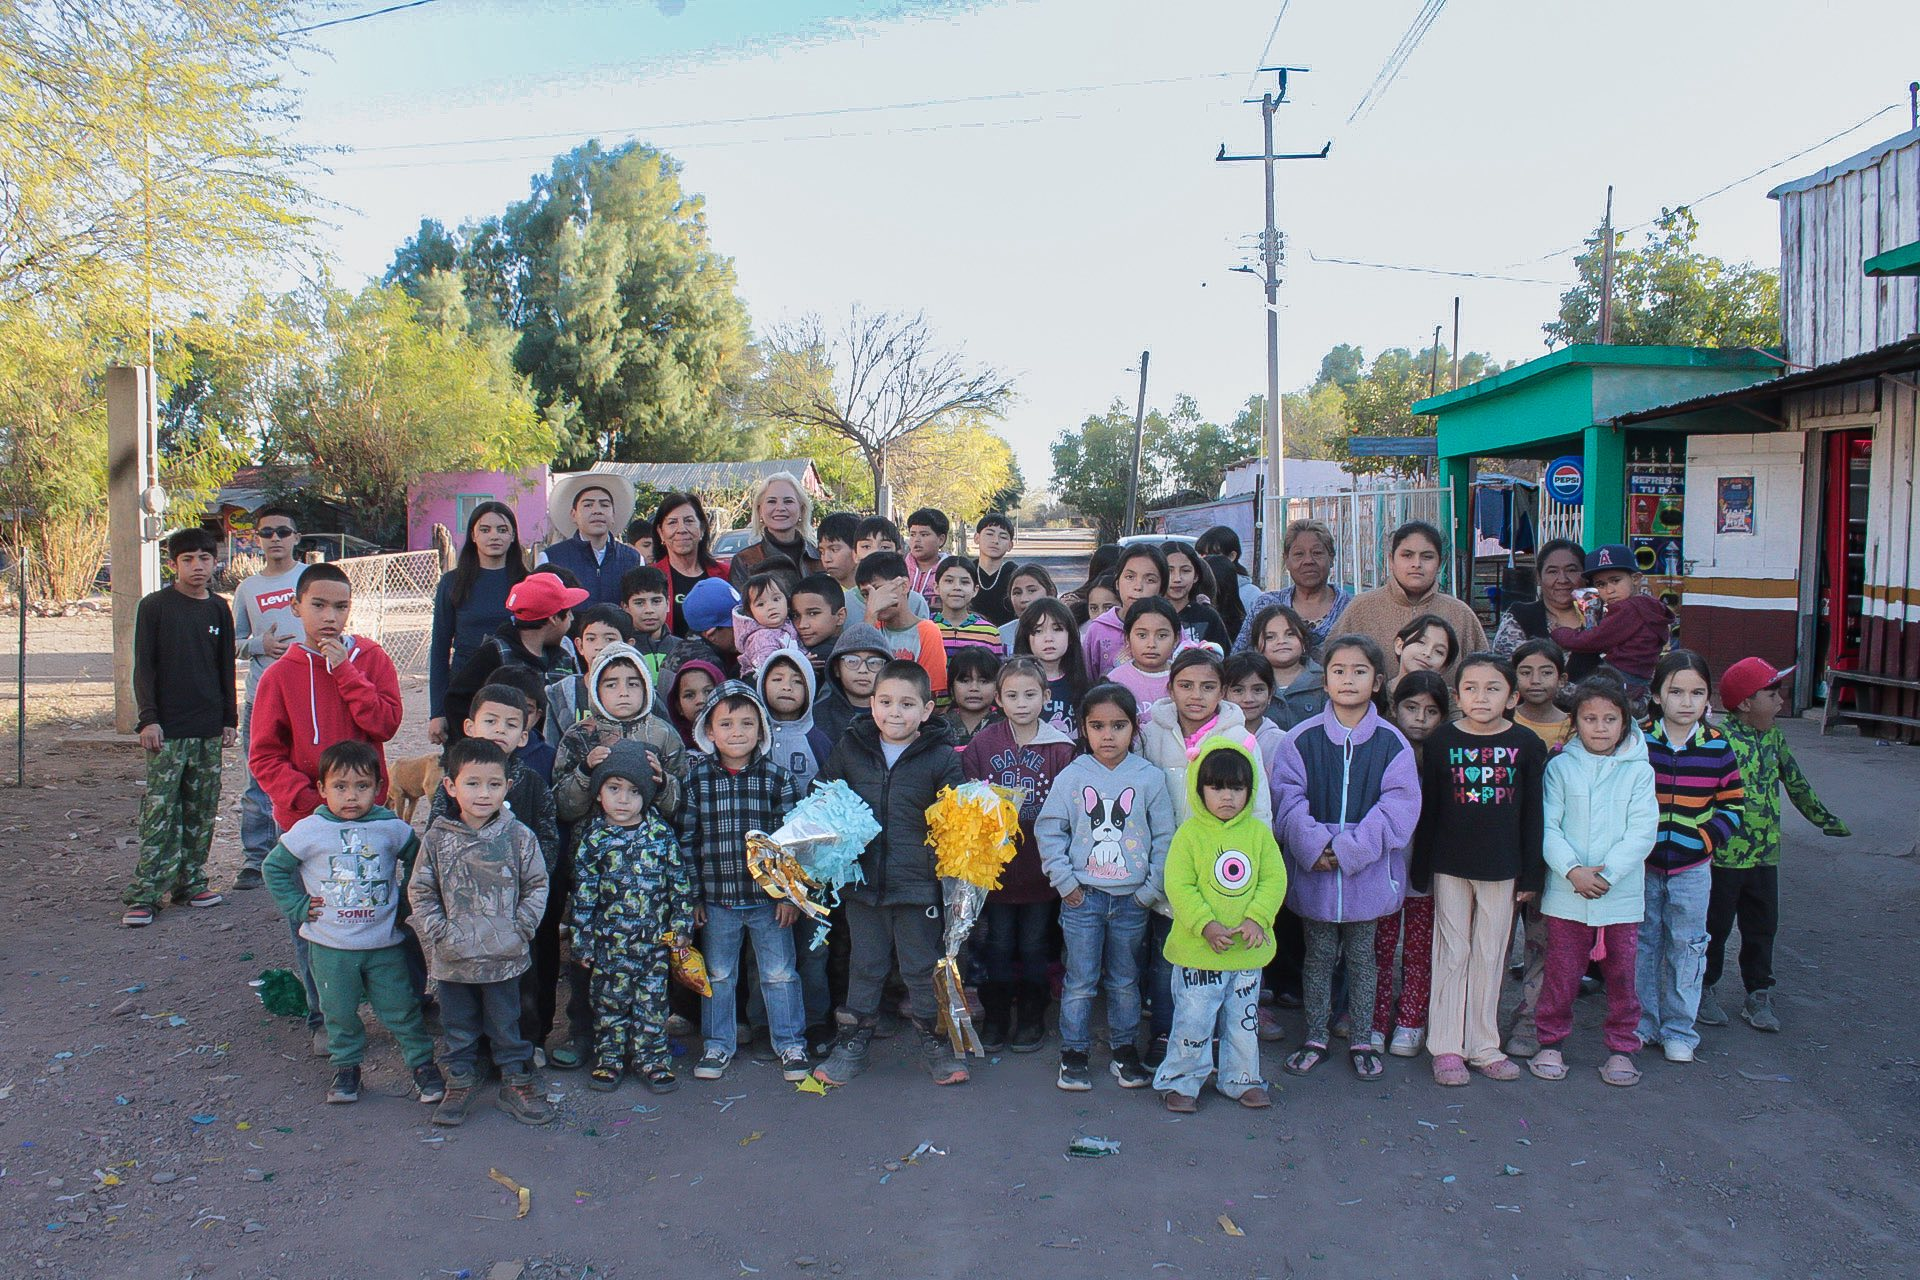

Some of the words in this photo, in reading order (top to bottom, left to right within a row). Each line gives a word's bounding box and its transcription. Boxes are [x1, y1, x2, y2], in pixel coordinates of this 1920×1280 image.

[1631, 475, 1684, 485] REFRESCA
[990, 749, 1045, 773] GAME
[1085, 855, 1131, 880] hello
[337, 909, 375, 918] SONIC
